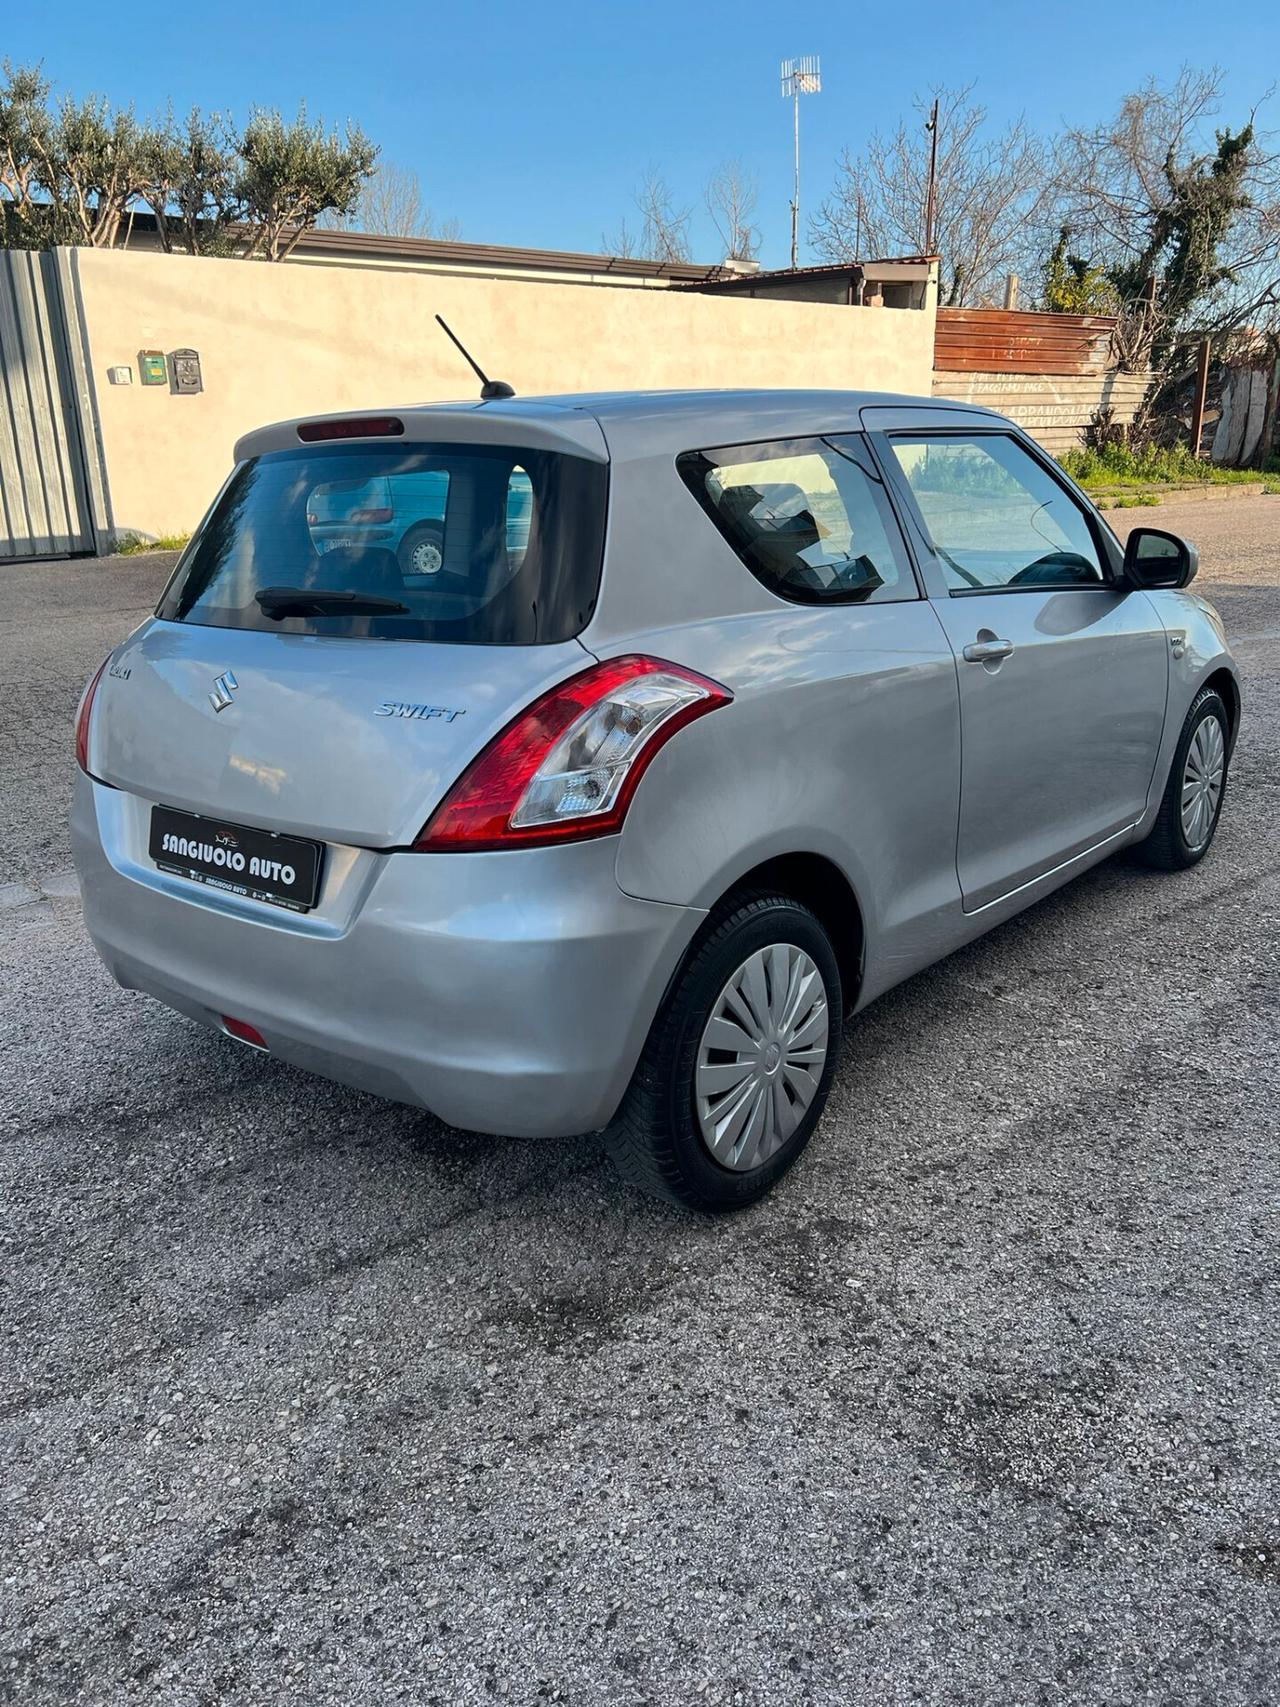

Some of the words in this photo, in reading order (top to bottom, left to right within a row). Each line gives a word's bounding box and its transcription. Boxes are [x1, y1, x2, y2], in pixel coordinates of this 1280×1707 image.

[372, 702, 467, 723] SWIFT
[162, 833, 246, 872] SANGIUOLO
[249, 856, 296, 885] AUTO
[232, 885, 248, 896] AUTO
